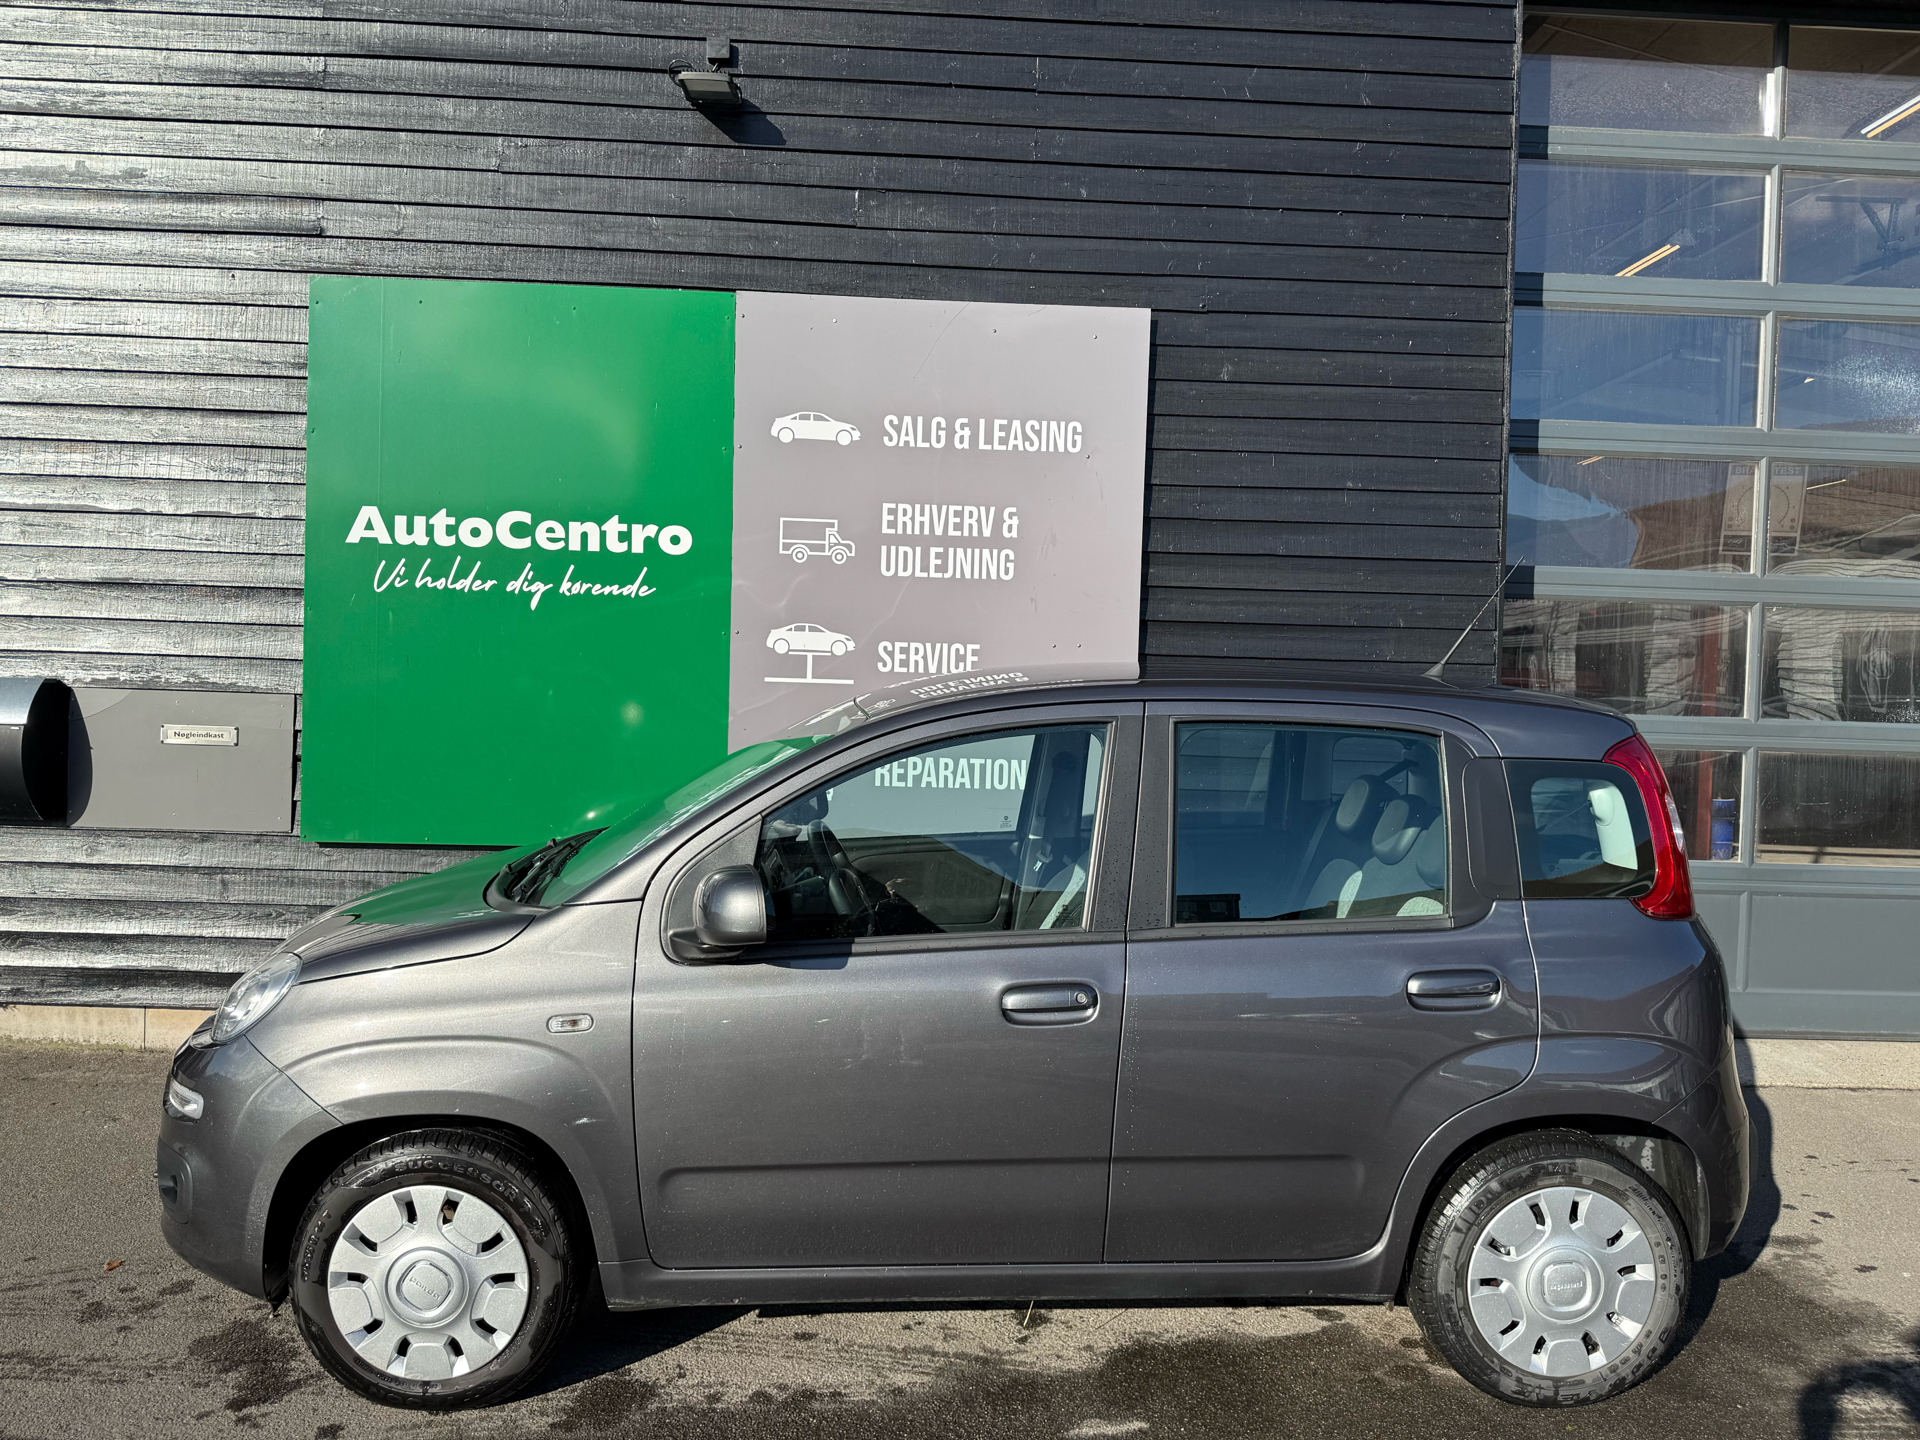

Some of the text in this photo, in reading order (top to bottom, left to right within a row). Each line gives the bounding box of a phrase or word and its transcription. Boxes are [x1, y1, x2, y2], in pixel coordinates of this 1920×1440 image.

[883, 414, 1083, 453] SALG & LEASING
[1774, 466, 1802, 475] TEST
[345, 505, 693, 556] AutoCentro
[881, 503, 1019, 539] ERHVERV &
[880, 545, 1015, 581] UDLEJNING
[373, 556, 657, 611] Vi holder dig kørende
[877, 640, 981, 674] SERVICE
[173, 731, 224, 739] Nøgleindkast
[874, 757, 1028, 791] REPARATION
[394, 1158, 518, 1203] SUCCESSOR
